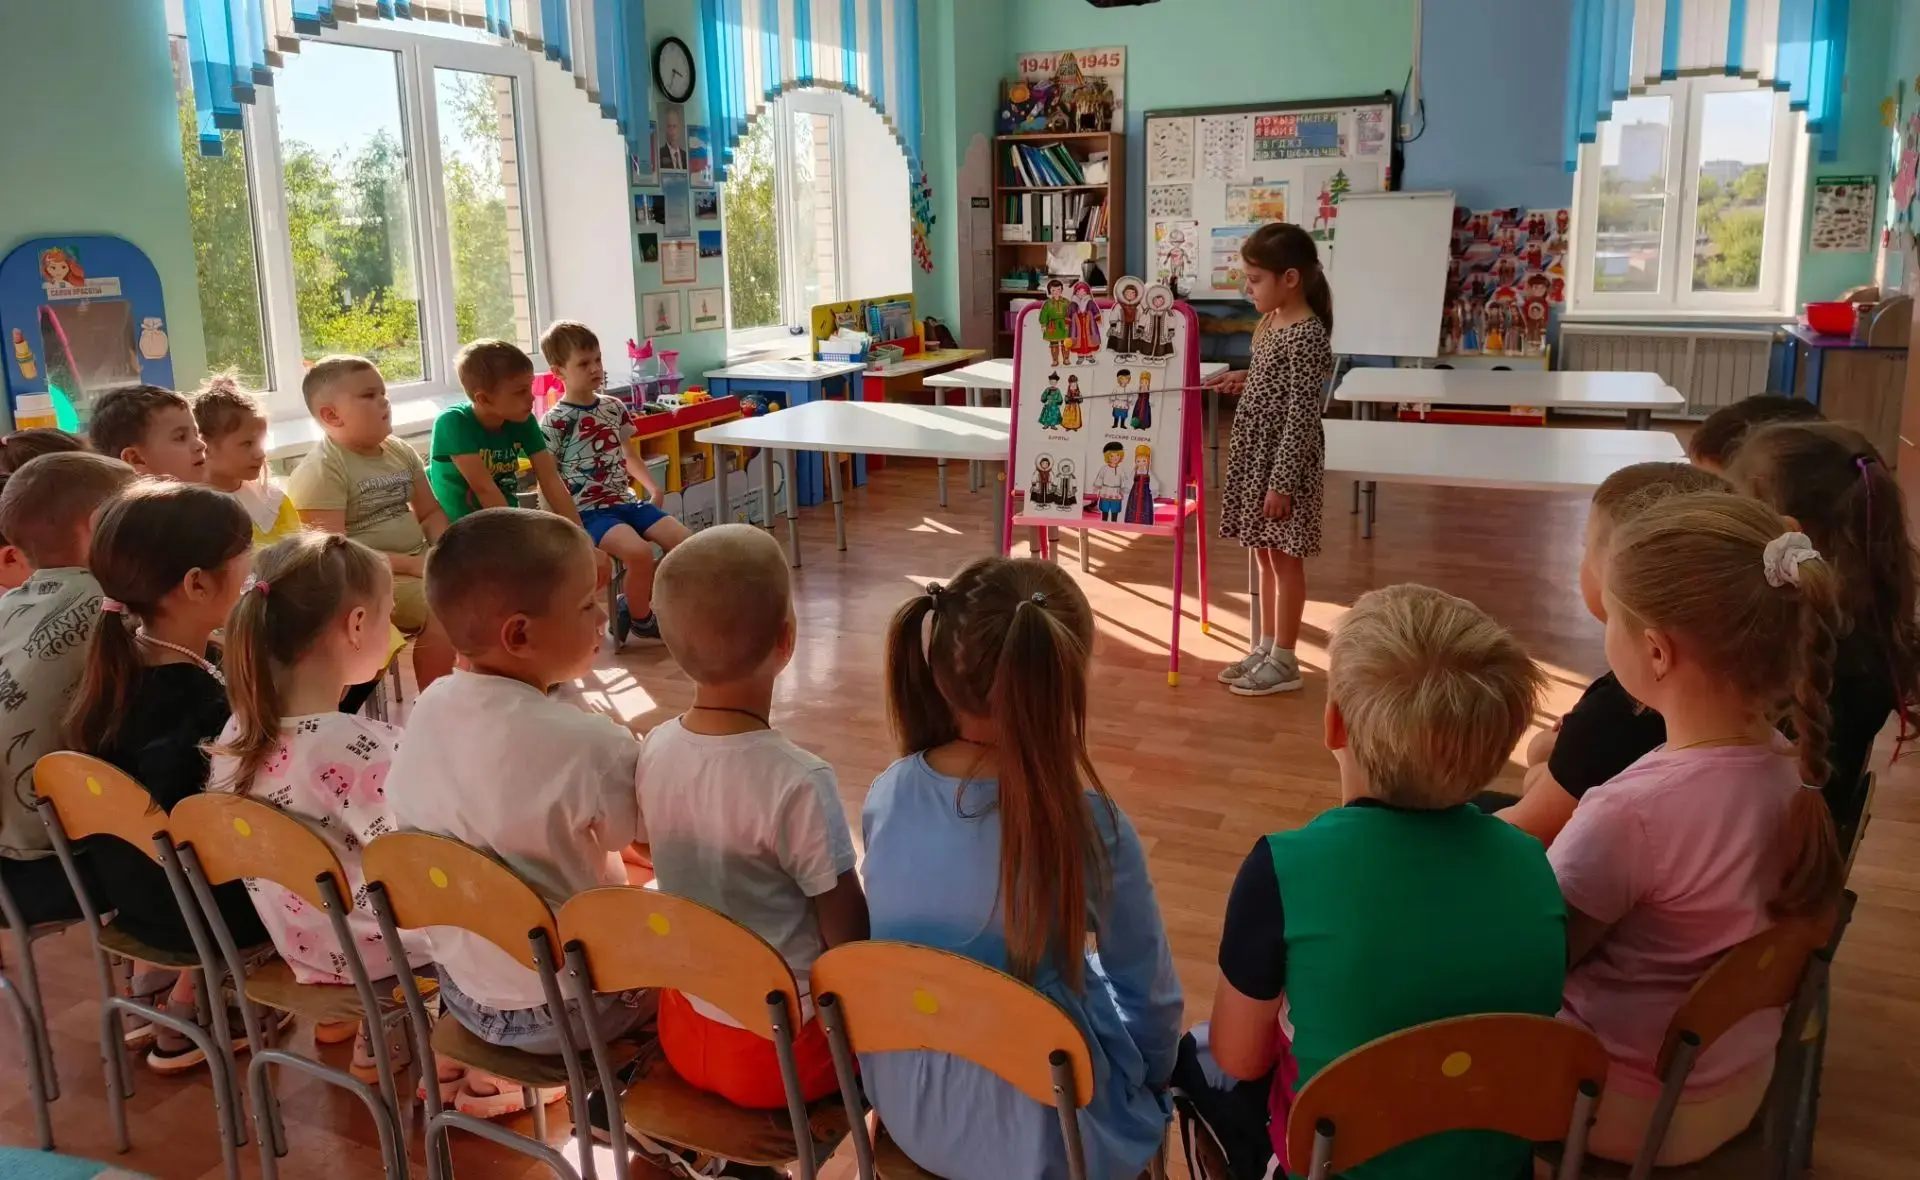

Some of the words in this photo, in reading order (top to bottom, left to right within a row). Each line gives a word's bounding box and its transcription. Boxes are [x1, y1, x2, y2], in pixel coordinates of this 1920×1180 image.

[1020, 56, 1057, 73] 1941
[1079, 52, 1120, 69] 1945
[345, 743, 362, 756] HEART
[277, 784, 292, 796] HEART
